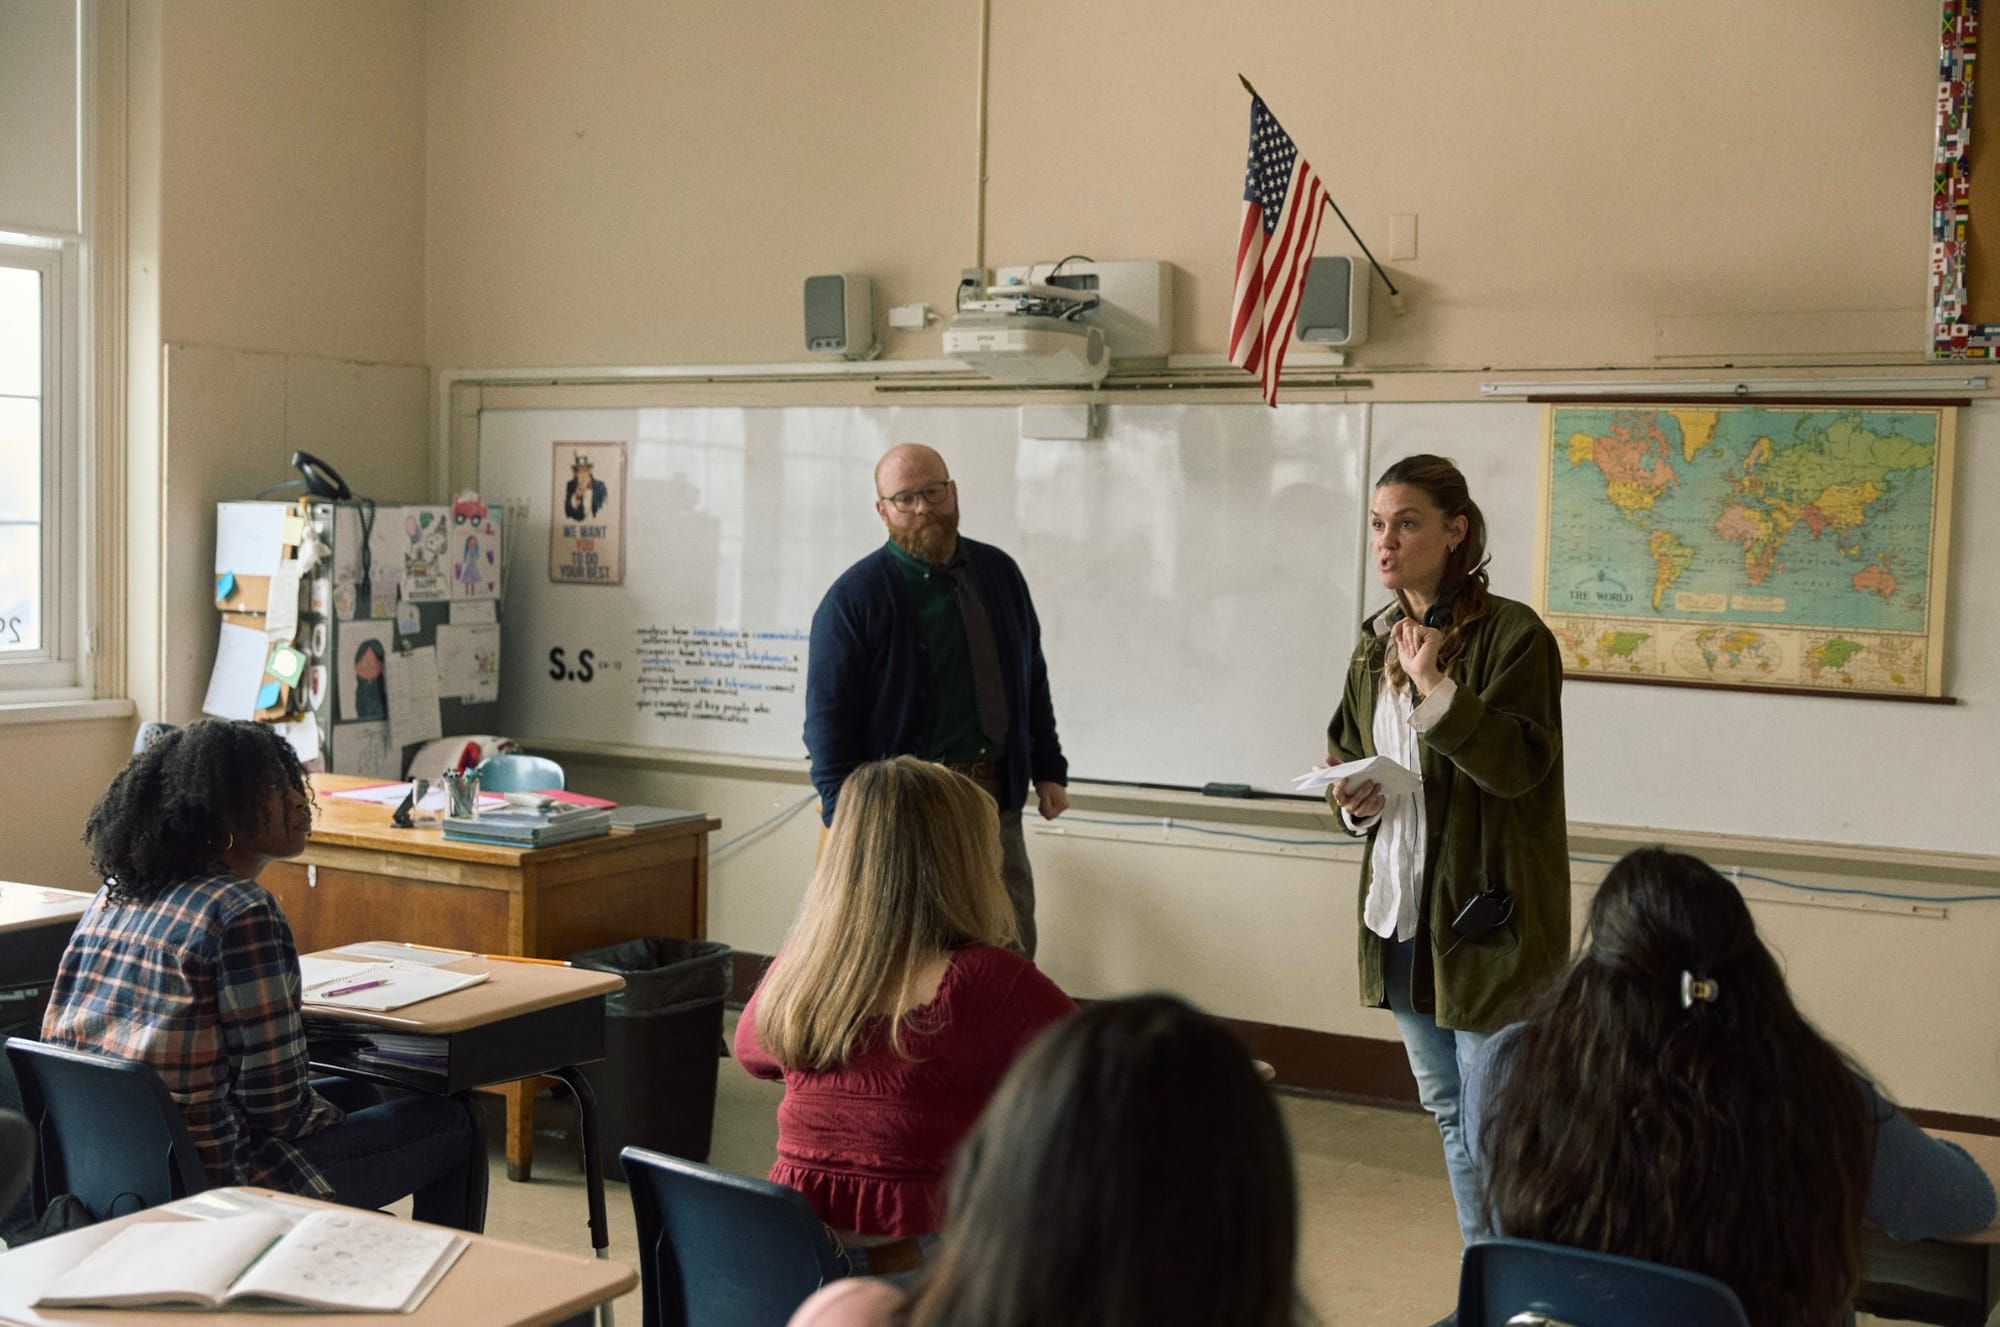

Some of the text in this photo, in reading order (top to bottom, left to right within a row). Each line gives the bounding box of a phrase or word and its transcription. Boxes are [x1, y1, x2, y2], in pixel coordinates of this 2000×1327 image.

[562, 525, 608, 540] WE WANT
[575, 538, 595, 552] YOU
[572, 552, 600, 566] TO DO
[559, 565, 611, 580] YOUR BEST
[1569, 591, 1635, 604] THE WORLD
